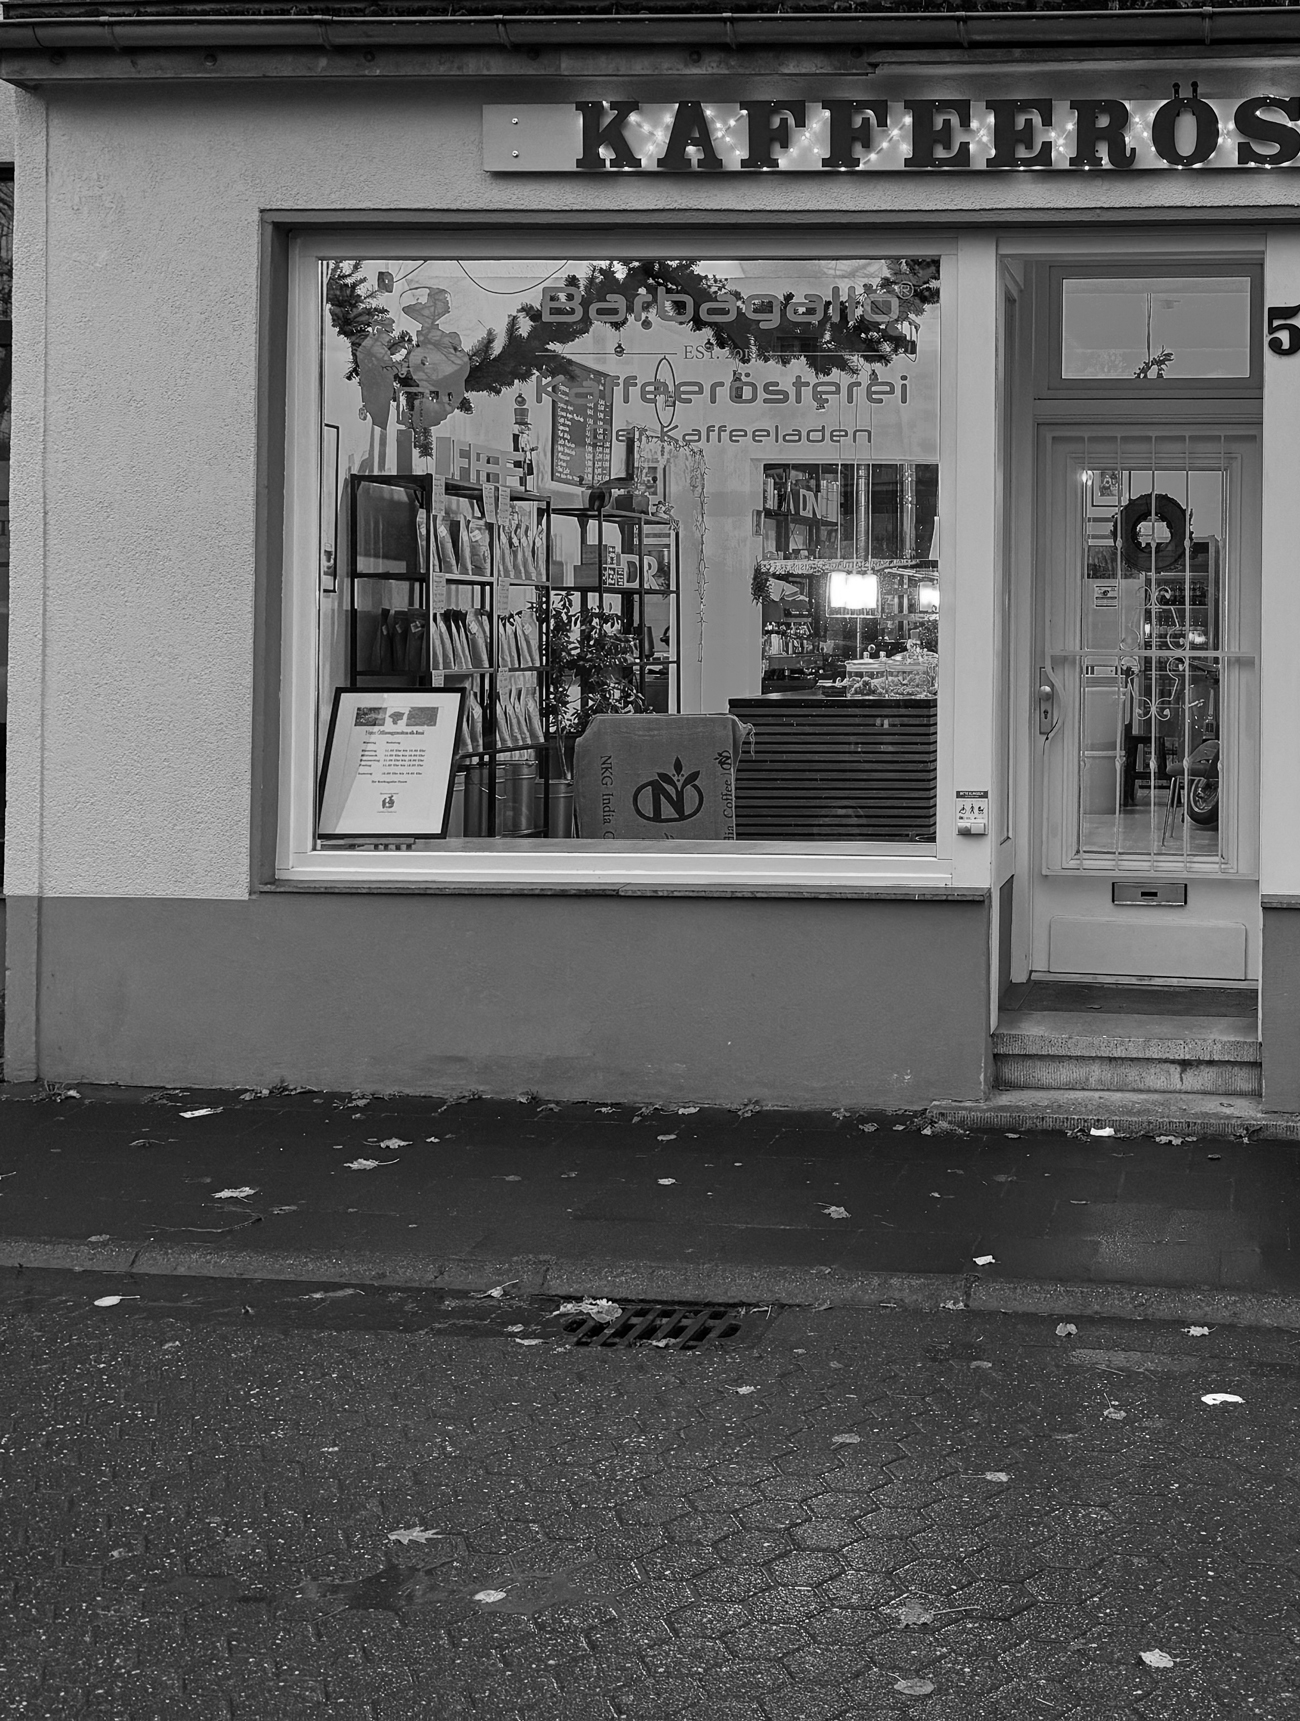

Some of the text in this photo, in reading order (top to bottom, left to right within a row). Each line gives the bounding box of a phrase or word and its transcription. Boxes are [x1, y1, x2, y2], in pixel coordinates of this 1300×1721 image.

[541, 285, 899, 330] Barbagallo
[535, 374, 908, 405] Kaffeerösterei
[660, 424, 872, 443] Kaffeeladen
[601, 755, 613, 786] NKG
[602, 793, 616, 825] India
